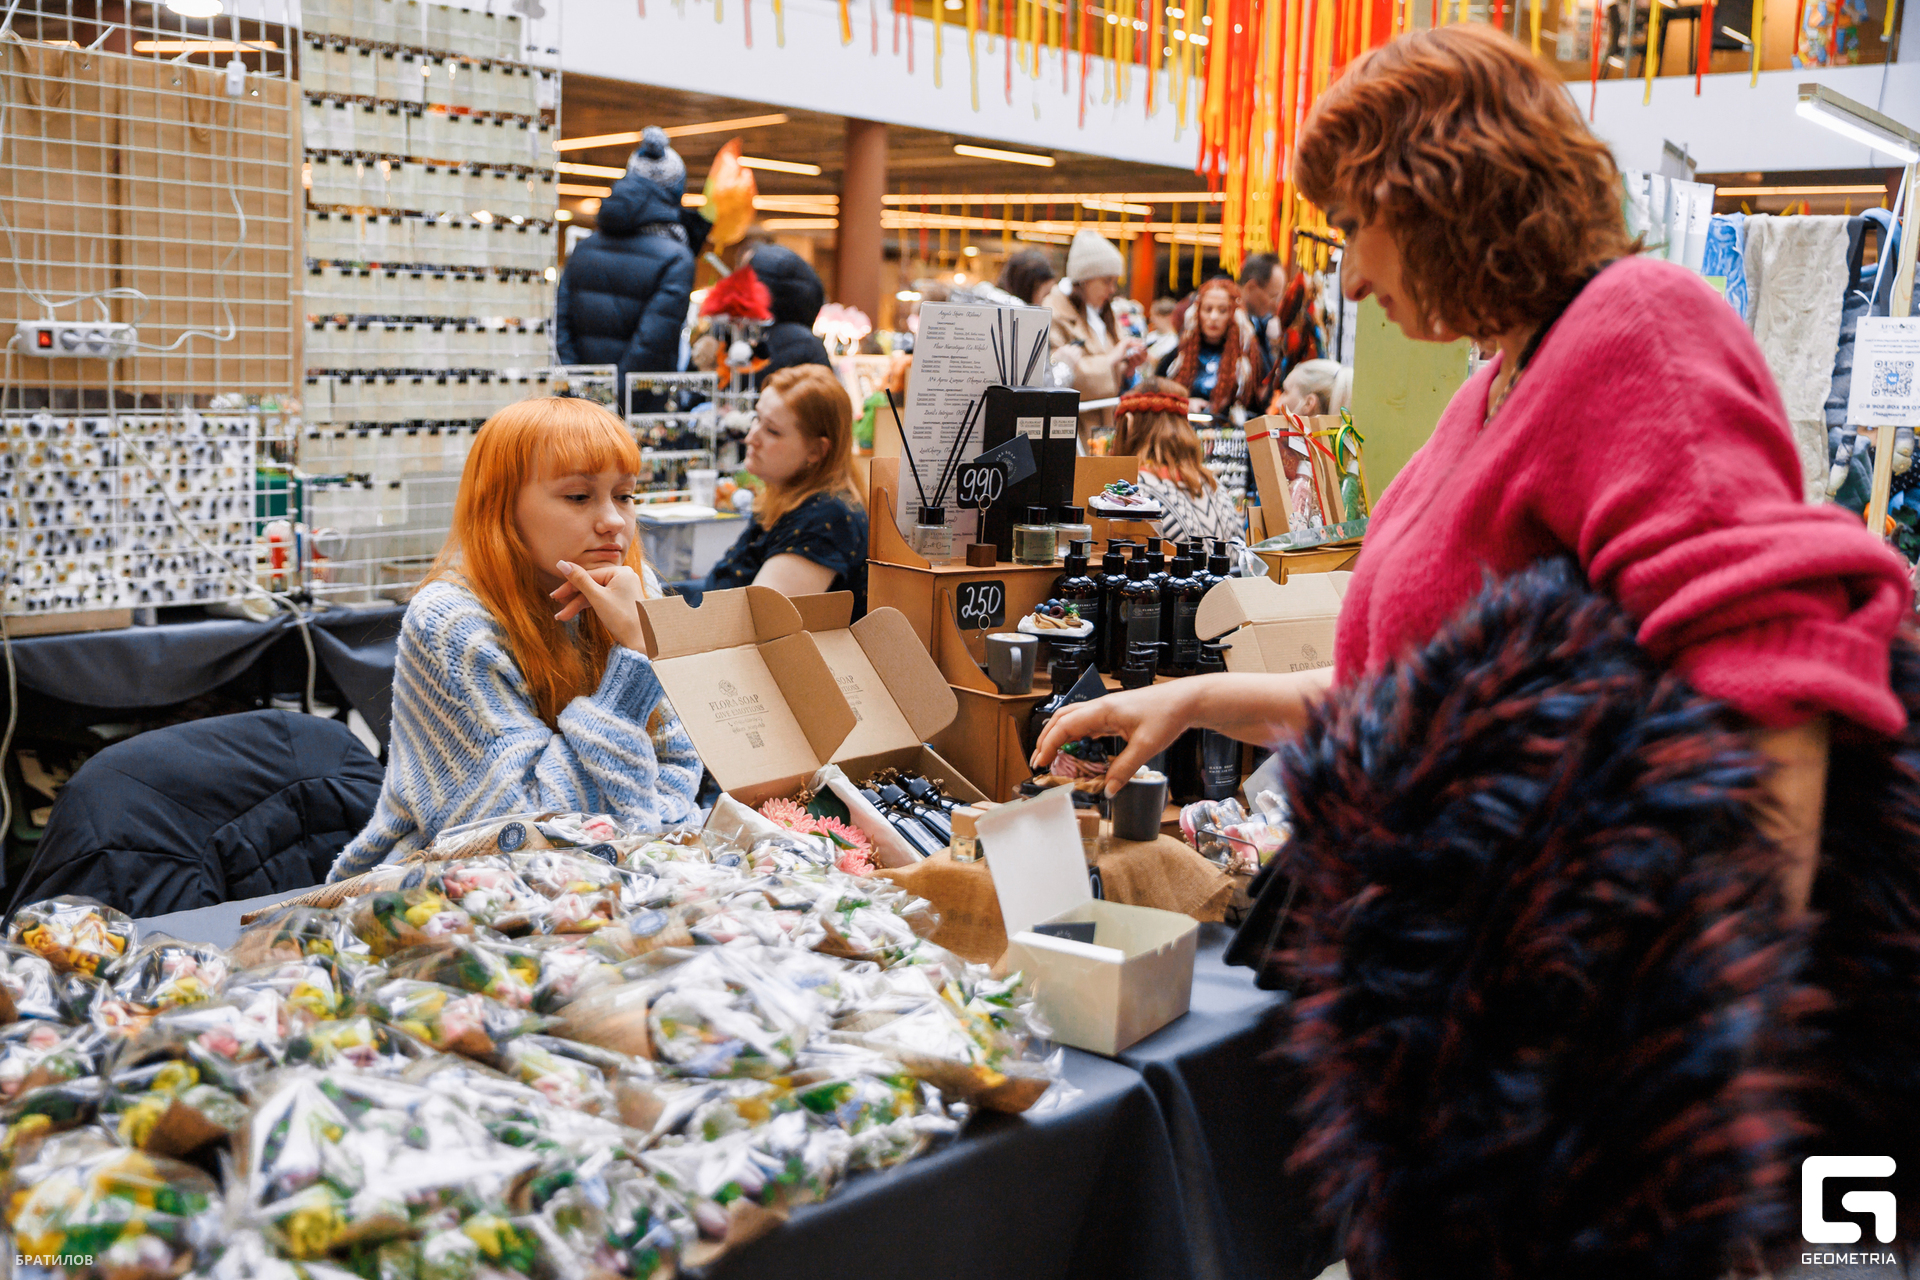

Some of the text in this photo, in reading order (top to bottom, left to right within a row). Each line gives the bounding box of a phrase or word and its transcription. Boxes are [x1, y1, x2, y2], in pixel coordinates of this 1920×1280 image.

[960, 468, 1003, 502] 990
[961, 586, 1001, 618] 250
[1290, 662, 1316, 672] FLORA
[836, 674, 854, 685] SOAP
[708, 694, 759, 712] FLORA SOAP
[715, 704, 765, 719] GIVE EMOTIONS
